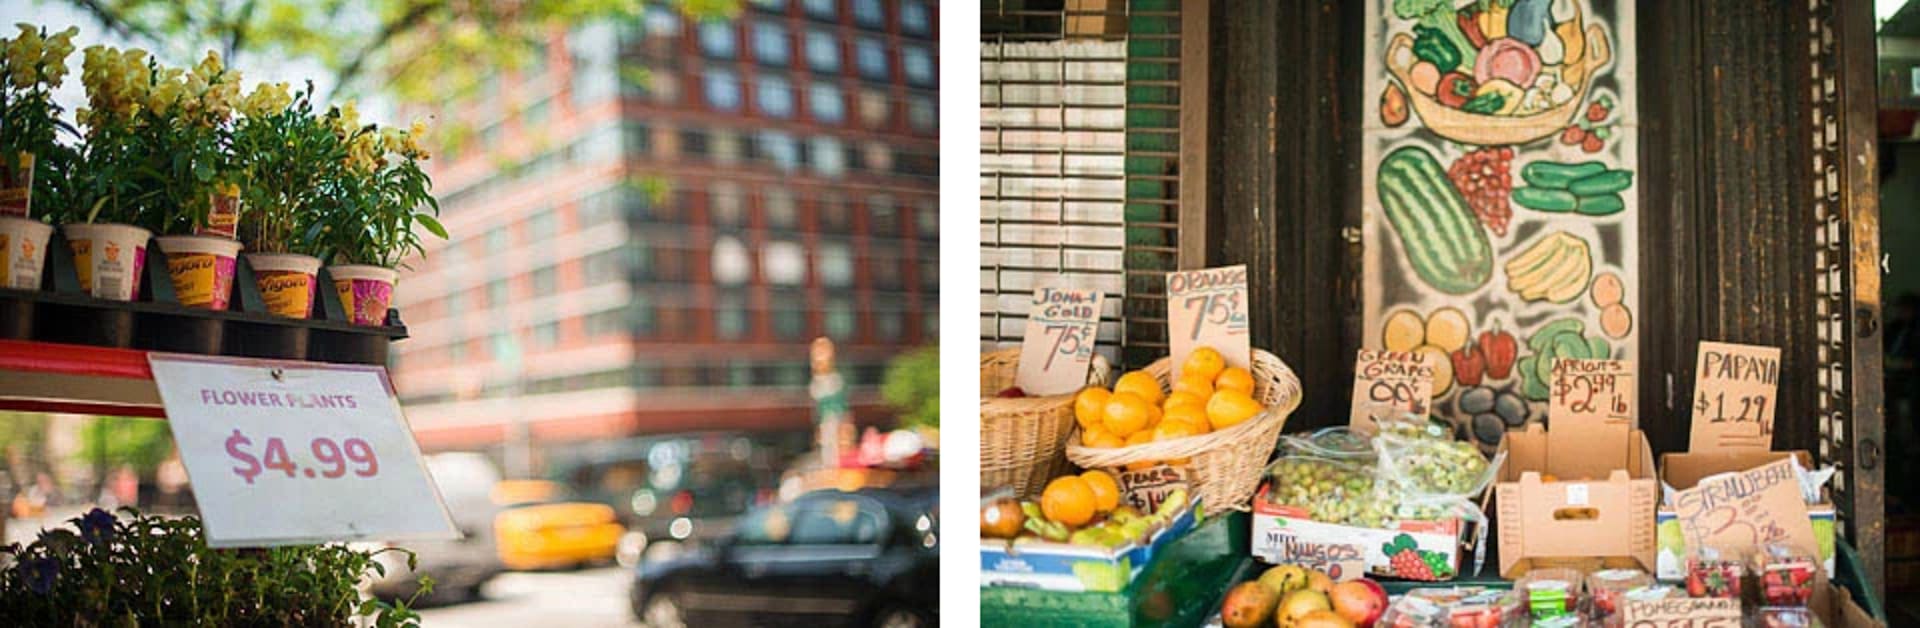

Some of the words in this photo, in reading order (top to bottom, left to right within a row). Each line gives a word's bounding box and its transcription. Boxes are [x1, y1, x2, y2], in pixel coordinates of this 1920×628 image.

[1703, 351, 1777, 385] PAPAYA
[201, 389, 282, 407] FLOWER
[1695, 391, 1768, 423] $1.29
[225, 428, 379, 485] $4.99
